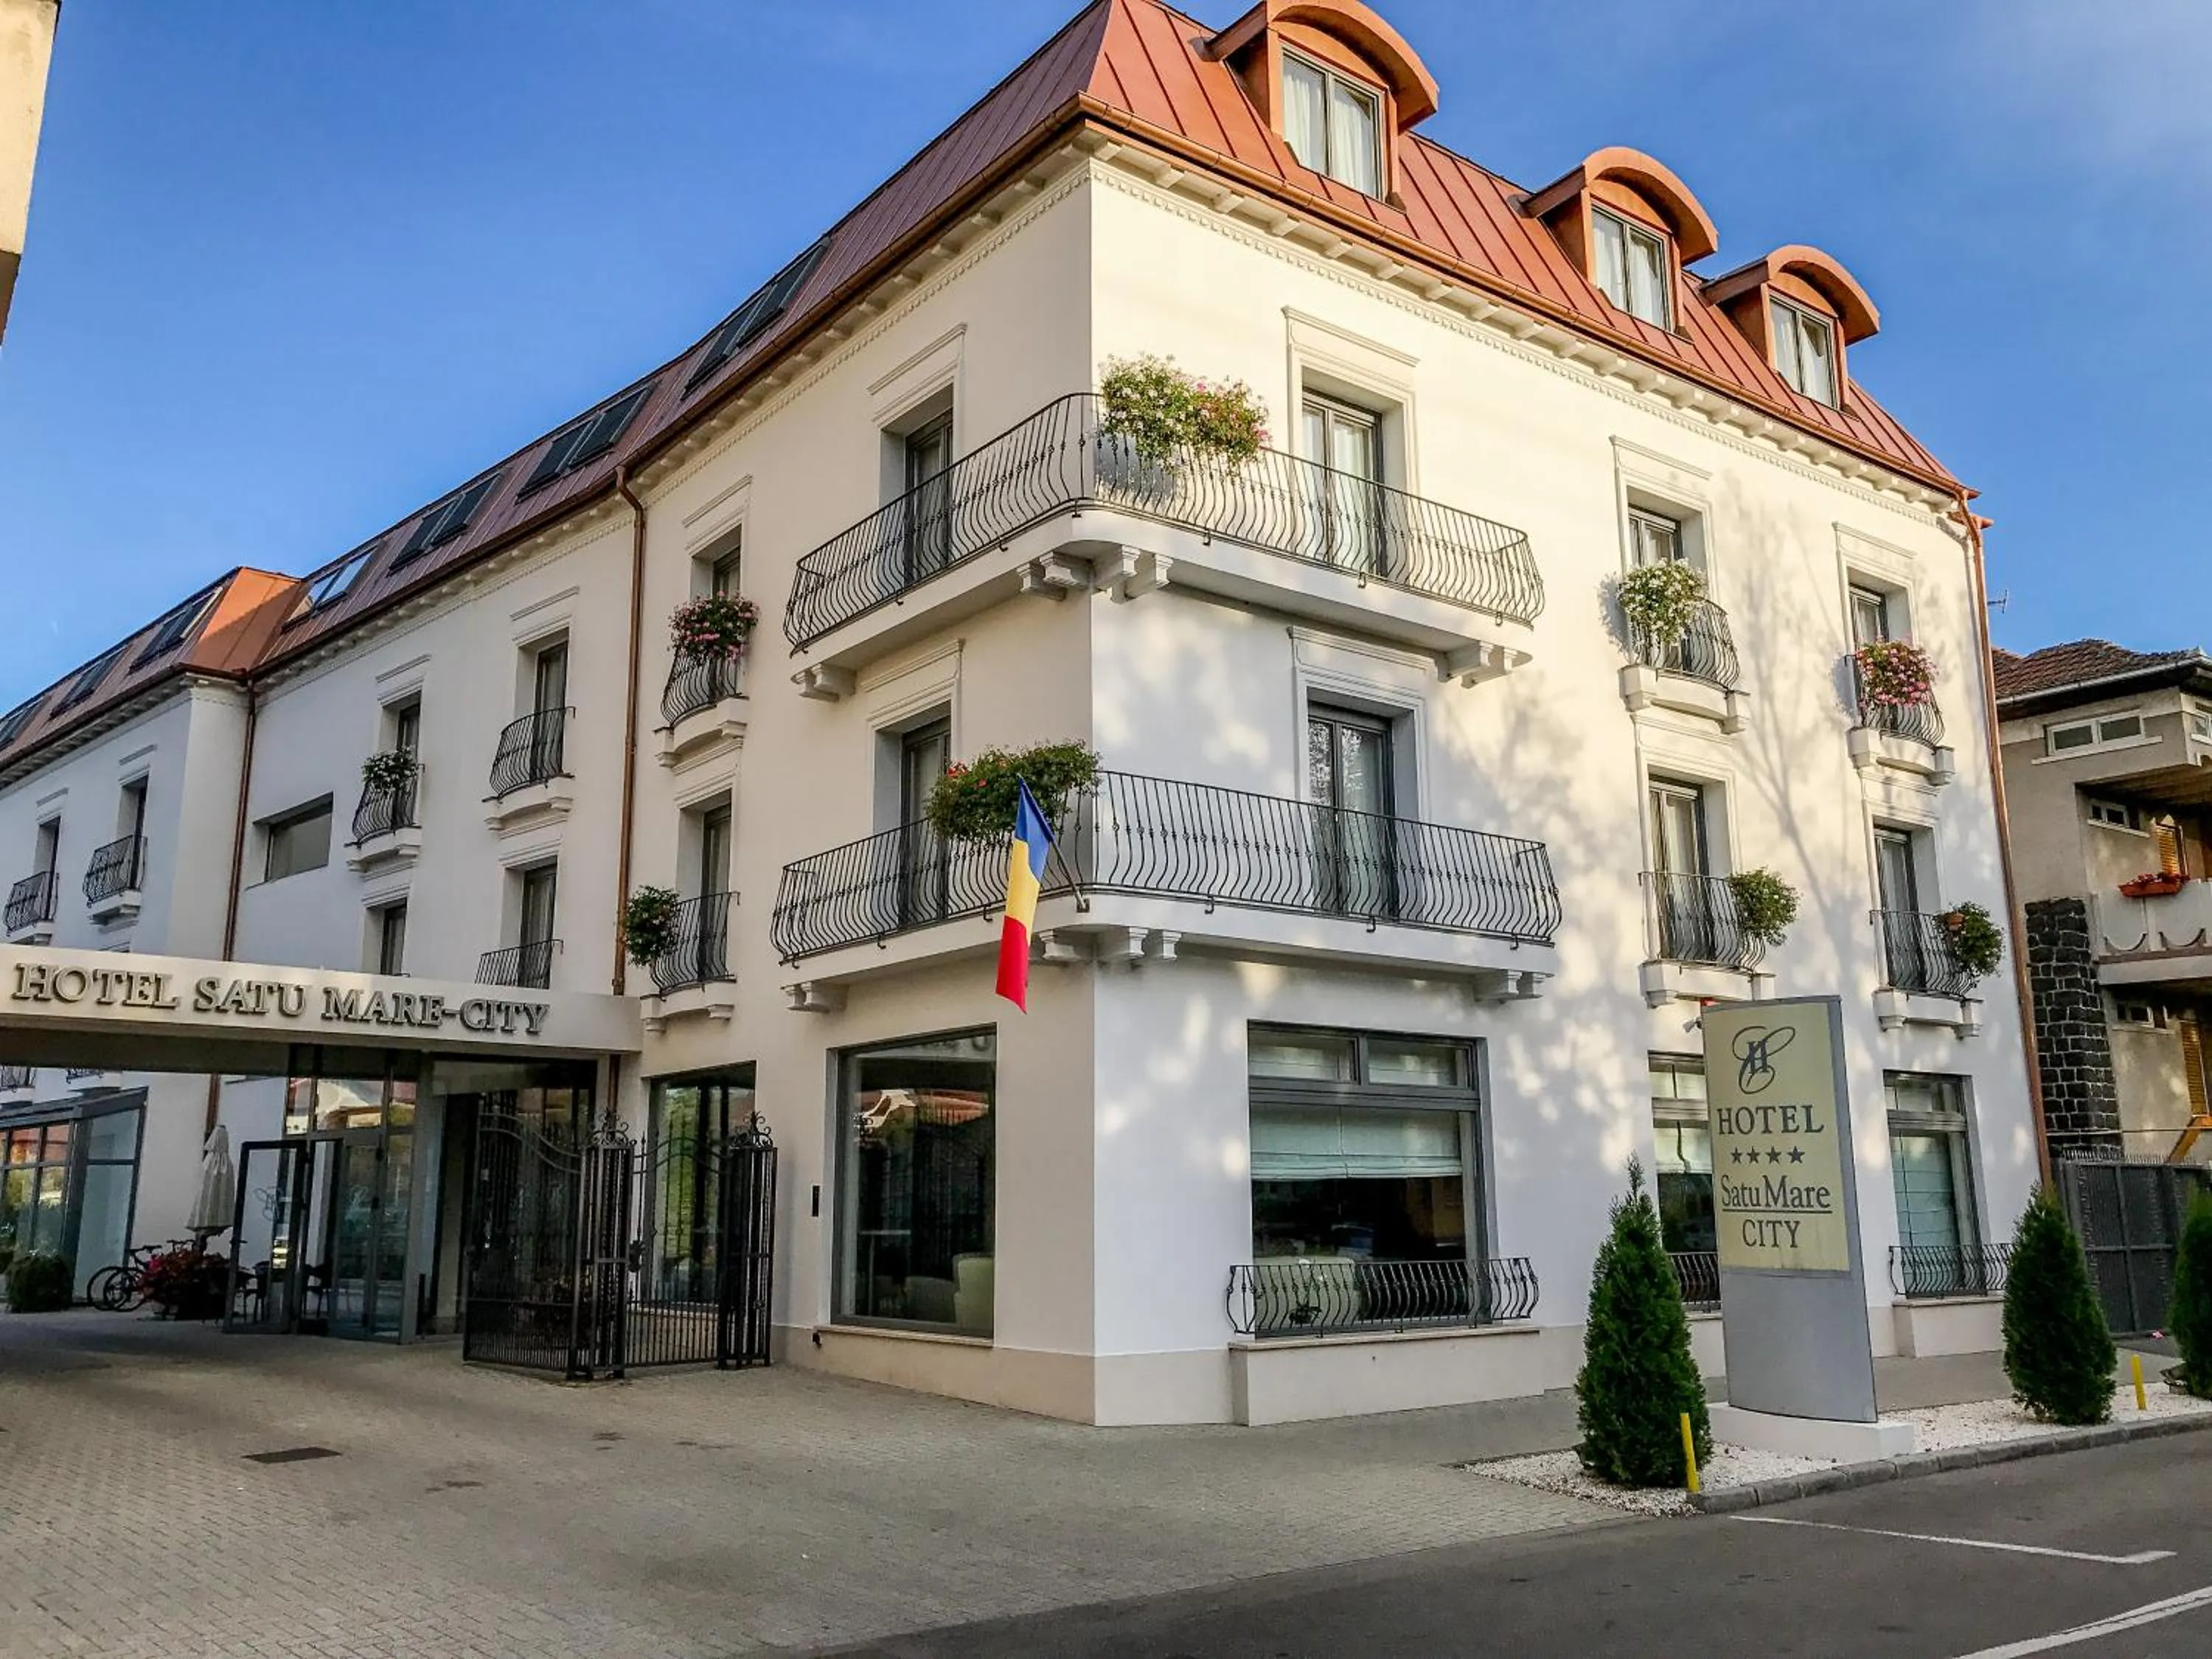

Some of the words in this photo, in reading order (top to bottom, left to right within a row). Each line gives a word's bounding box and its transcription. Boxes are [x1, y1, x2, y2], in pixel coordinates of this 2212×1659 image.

[12, 962, 178, 1009] HOTEL
[194, 977, 306, 1016] SATU
[321, 987, 550, 1035] MARE-CITY
[1717, 1105, 1824, 1135] HOTEL
[1742, 1219, 1801, 1248] CITY
